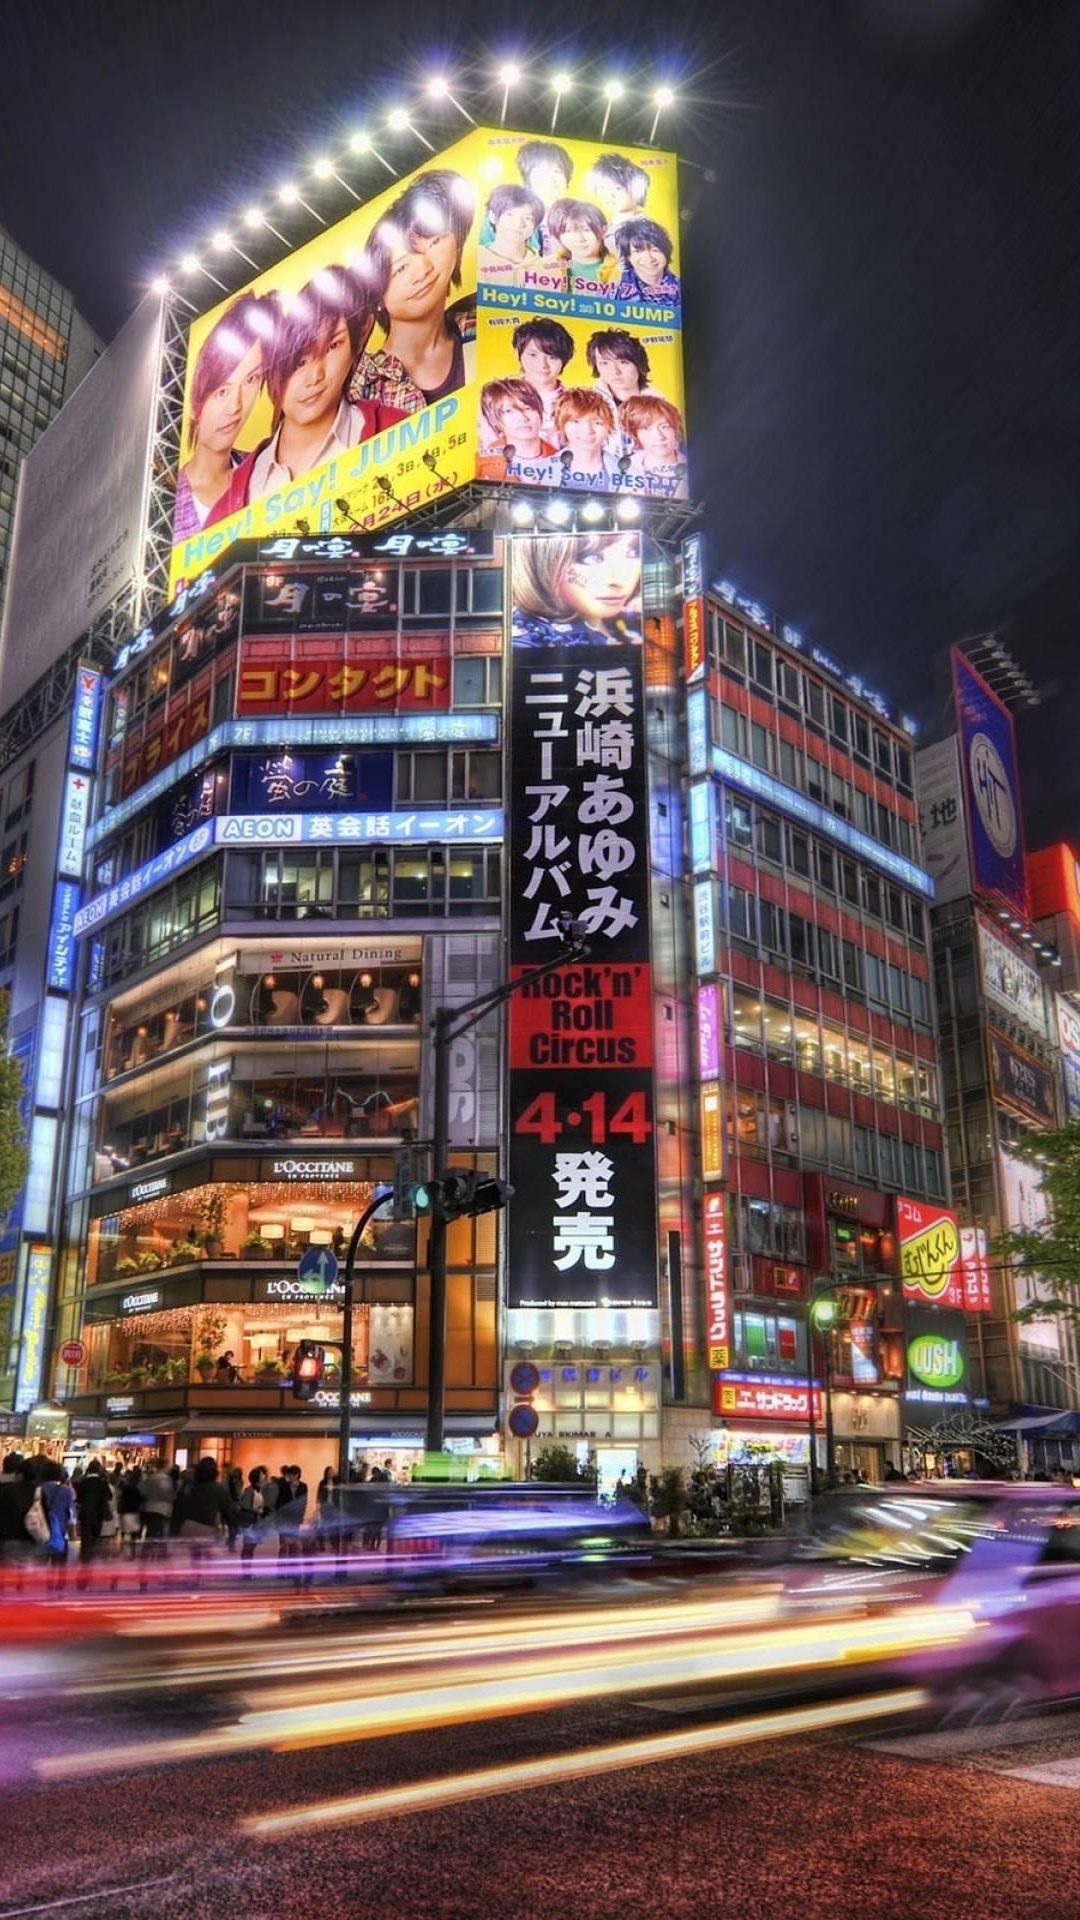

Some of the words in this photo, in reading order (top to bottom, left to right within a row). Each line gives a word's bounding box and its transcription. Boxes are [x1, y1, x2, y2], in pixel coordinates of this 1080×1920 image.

[525, 271, 568, 290] Hey!
[575, 278, 615, 296] Say!
[483, 288, 527, 305] Hey!
[534, 295, 575, 311] Say!
[621, 308, 675, 323] JUMP
[183, 507, 252, 569] Hey!
[264, 462, 337, 523] Say!
[350, 397, 459, 478] JUMP
[508, 463, 553, 482] Hey!
[561, 468, 604, 485] Say!
[242, 665, 446, 700] コンタクト
[234, 727, 251, 739] 7F
[522, 672, 572, 942] ニューアルバム
[574, 667, 639, 939] 浜崎あゆみ
[70, 799, 82, 863] 献血ルーム
[225, 819, 294, 839] AEON
[309, 815, 496, 839] 英会話イーオン
[108, 844, 186, 911] 英会話イーオン
[76, 897, 107, 932] AEON
[291, 949, 344, 963] Natural
[352, 948, 402, 962] Dining
[521, 966, 641, 999] Rock'n'
[552, 1000, 613, 1032] Roll
[529, 1032, 636, 1065] Circus
[274, 1160, 354, 1173] L'OCCITANE
[551, 1151, 615, 1271] 発売
[913, 1341, 957, 1377] LUSH
